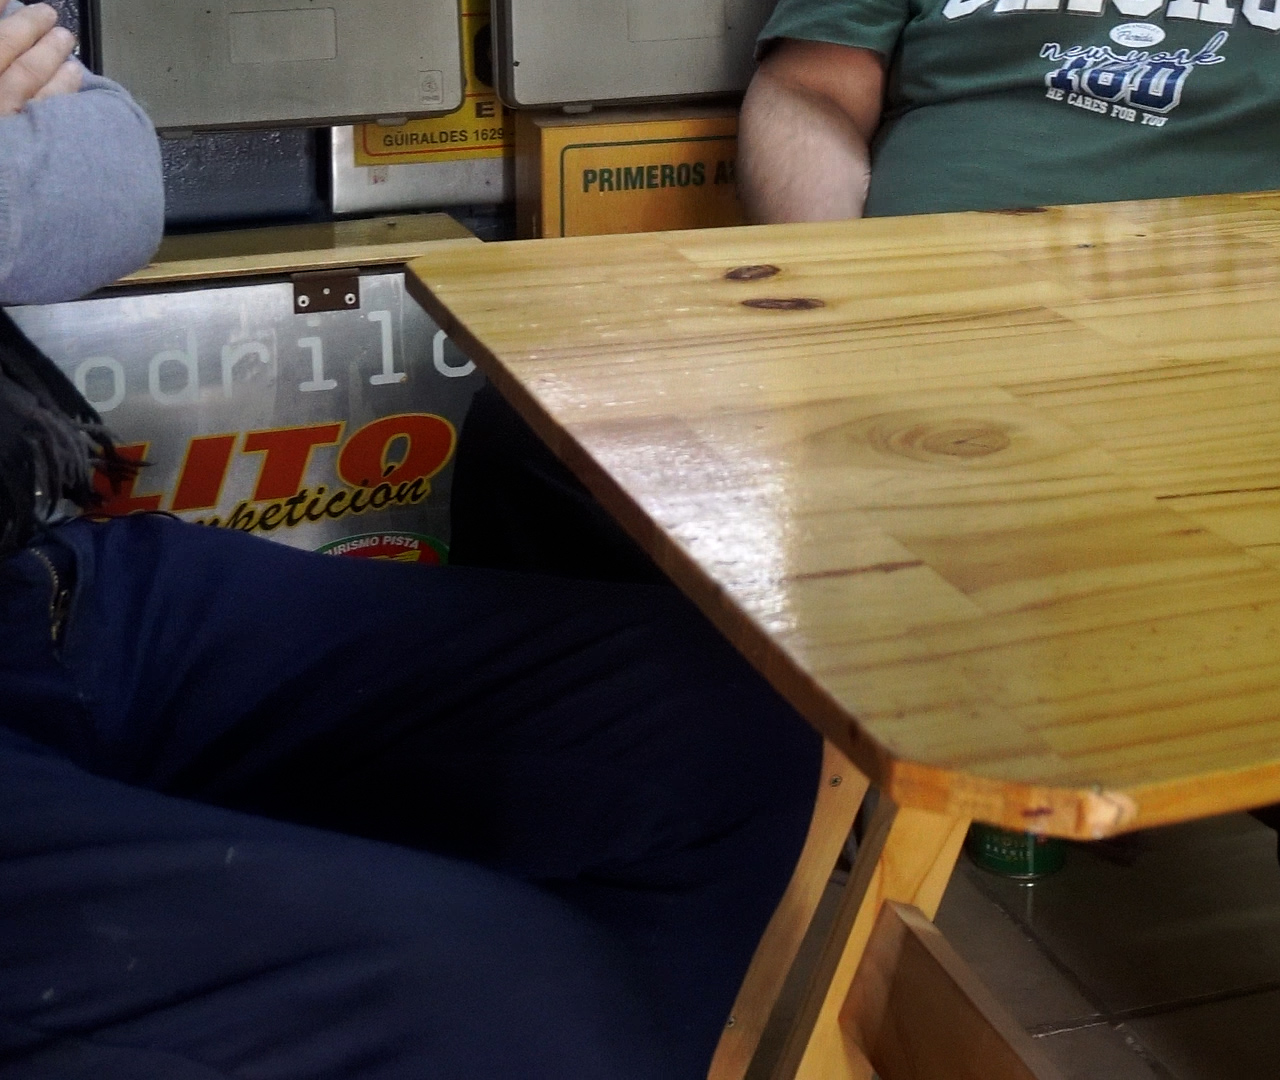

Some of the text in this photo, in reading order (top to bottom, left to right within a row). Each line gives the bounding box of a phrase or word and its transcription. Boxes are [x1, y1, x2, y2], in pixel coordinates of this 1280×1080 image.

[1067, 92, 1109, 115] CARES
[1110, 104, 1137, 123] FOR
[1140, 113, 1169, 128] YOU
[383, 128, 505, 147] GÜIRALDES 1629
[583, 162, 706, 193] PRIMEROS
[74, 310, 477, 412] odrilo
[382, 535, 420, 550] PISTA
